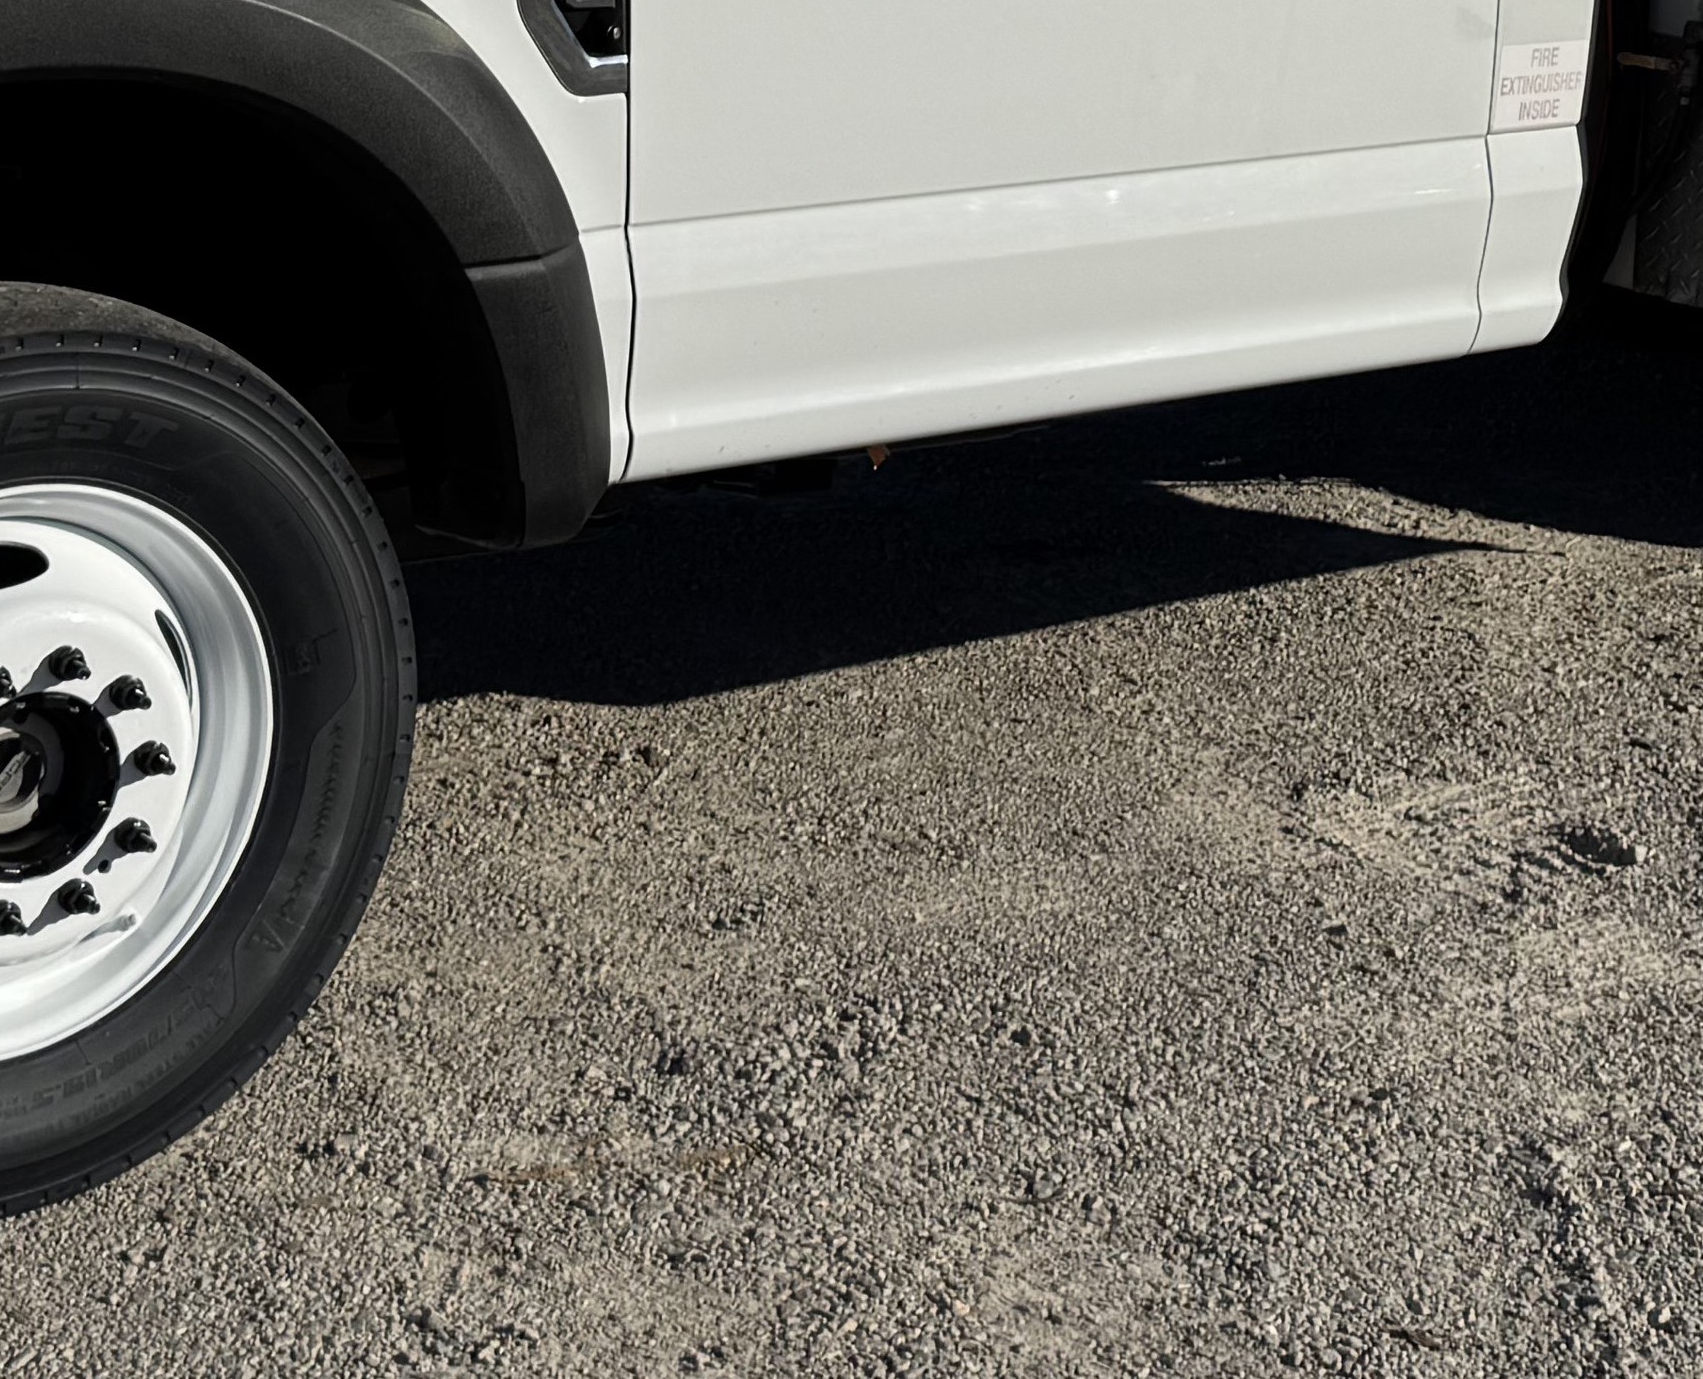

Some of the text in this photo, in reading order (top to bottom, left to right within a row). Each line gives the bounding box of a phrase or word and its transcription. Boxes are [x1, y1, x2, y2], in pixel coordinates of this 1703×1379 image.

[1530, 46, 1560, 68] FIRE
[1500, 70, 1583, 97] EXTINGUISHER
[1518, 98, 1560, 121] INSIDE
